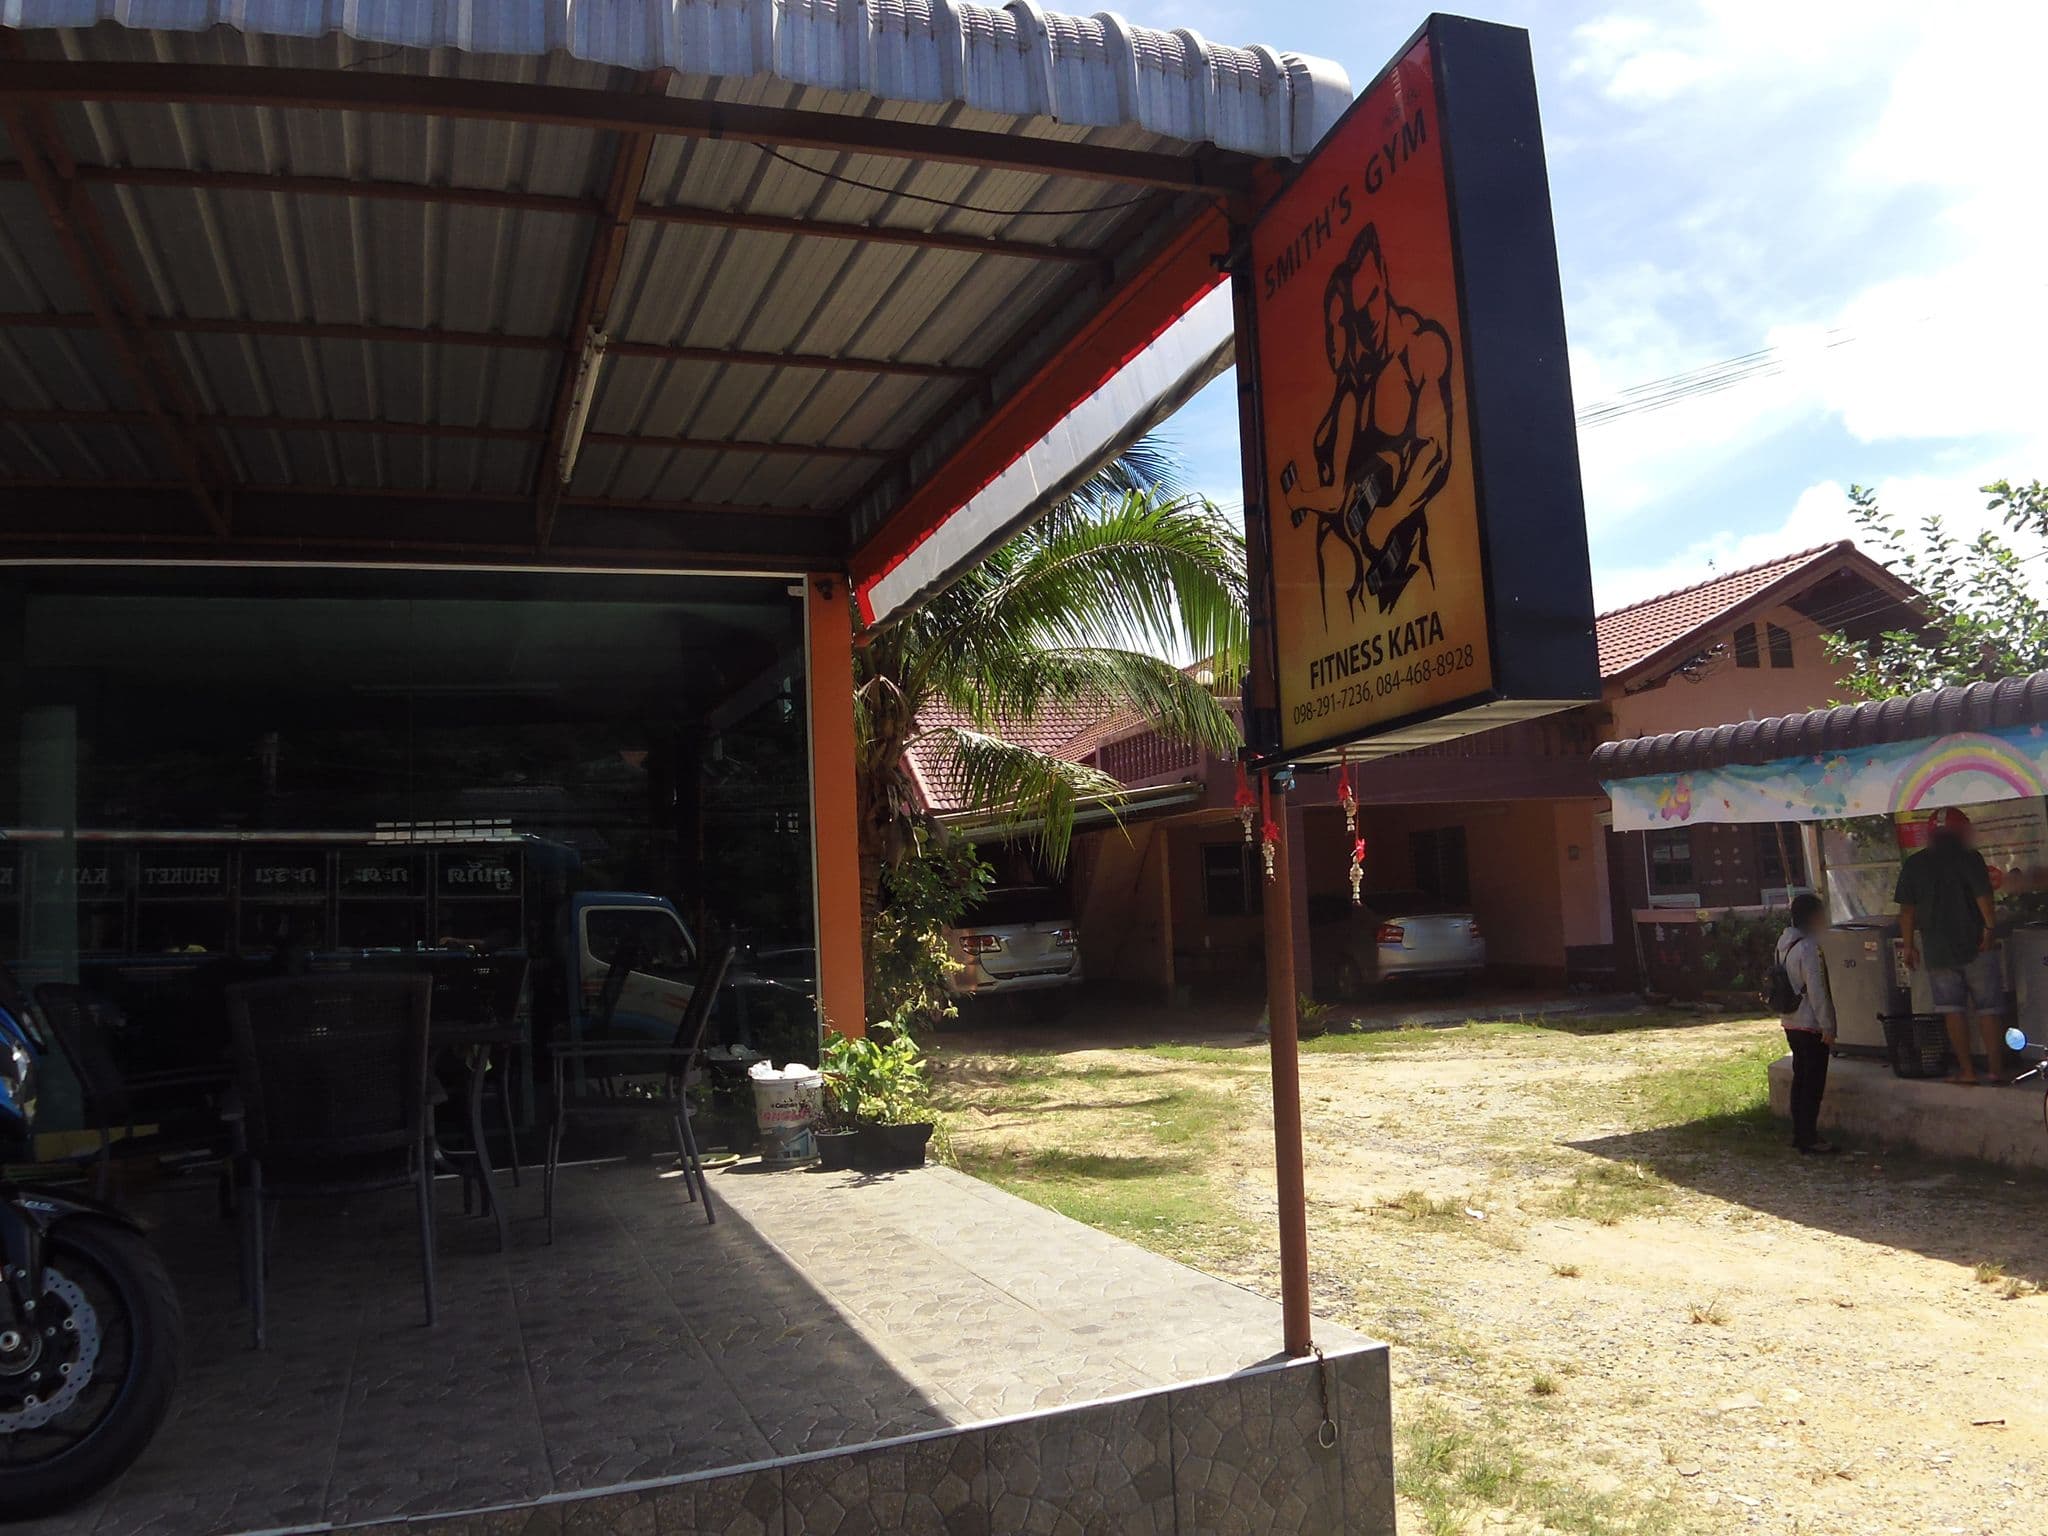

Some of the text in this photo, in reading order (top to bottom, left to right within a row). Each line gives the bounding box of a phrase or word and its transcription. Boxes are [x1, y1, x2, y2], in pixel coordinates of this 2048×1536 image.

[1264, 109, 1427, 298] SMITH'S GYM
[1293, 643, 1474, 725] 098-291-7236, 084-468-8928
[1309, 610, 1445, 690] FITNESS KATA
